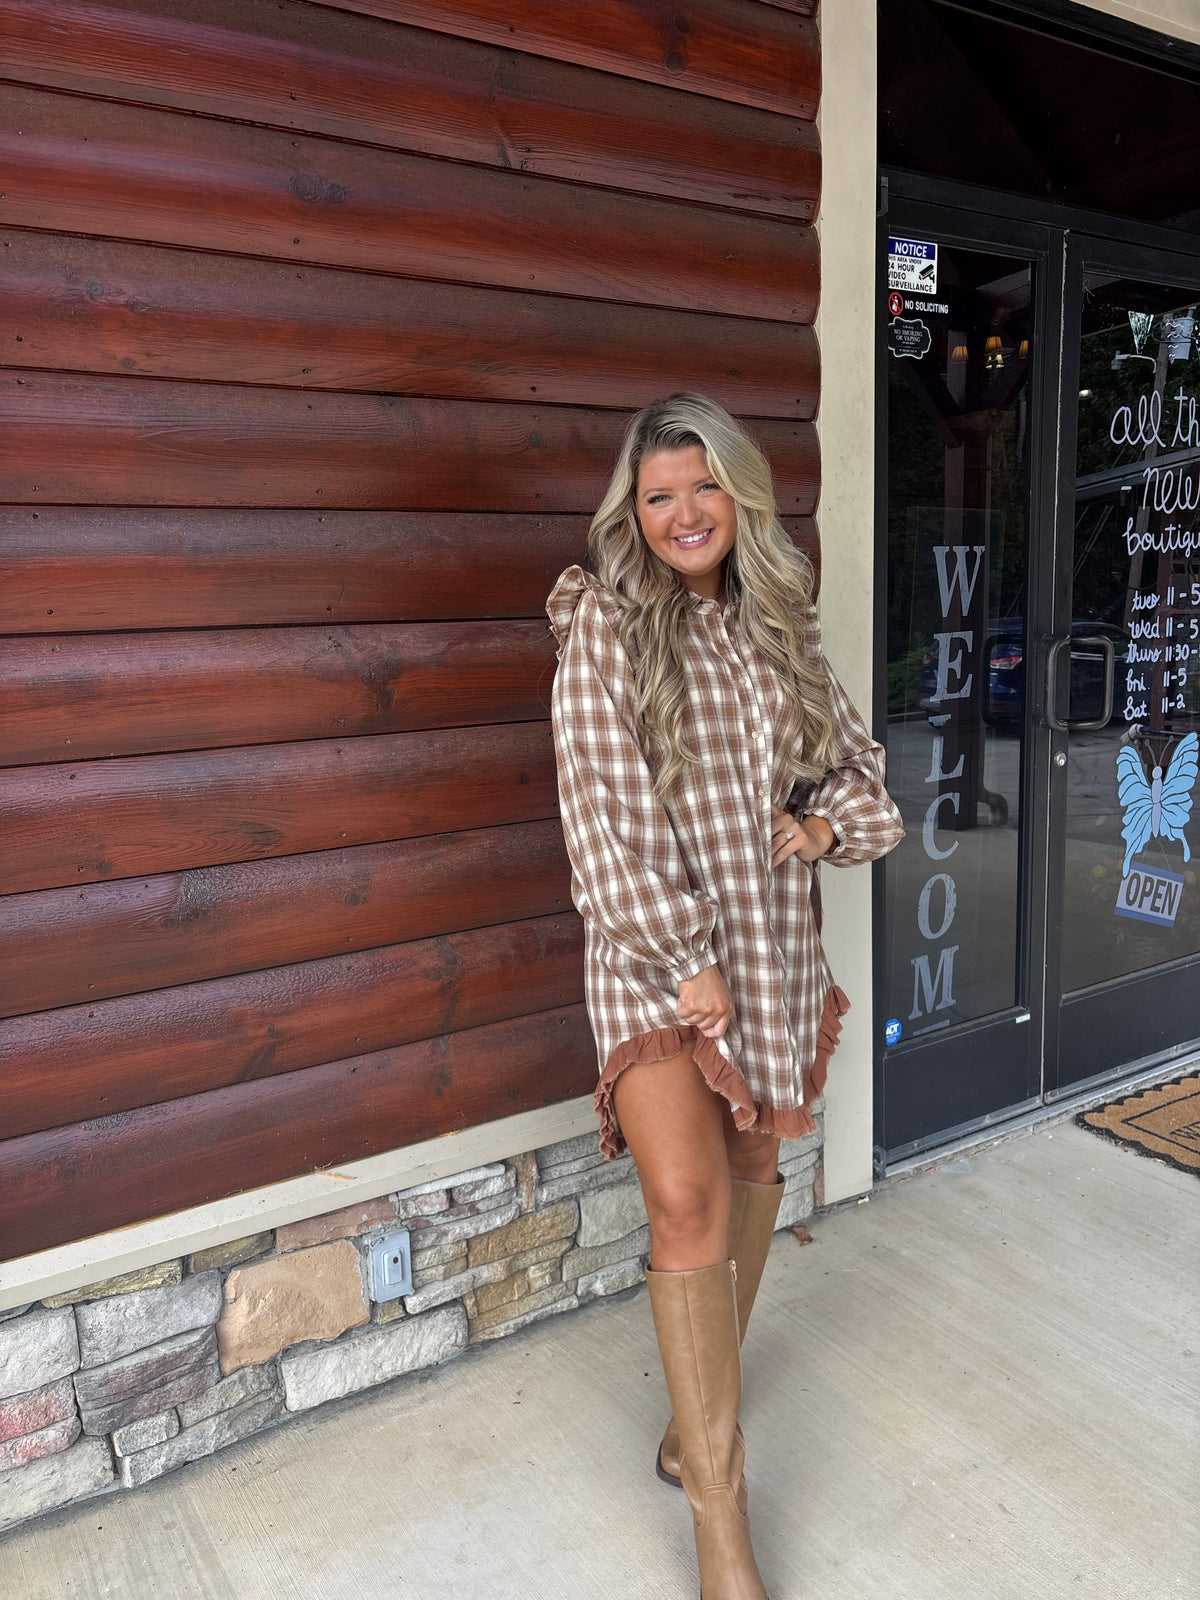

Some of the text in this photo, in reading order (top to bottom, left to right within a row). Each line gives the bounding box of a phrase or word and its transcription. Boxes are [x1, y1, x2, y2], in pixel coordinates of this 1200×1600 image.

[894, 241, 928, 258] NOTICE
[897, 263, 915, 272] HOUR
[904, 299, 949, 314] NO SOLICITING
[1110, 390, 1167, 448] all
[907, 545, 986, 1037] WELCOM
[1125, 872, 1179, 916] OPEN
[886, 1023, 899, 1035] ADT
